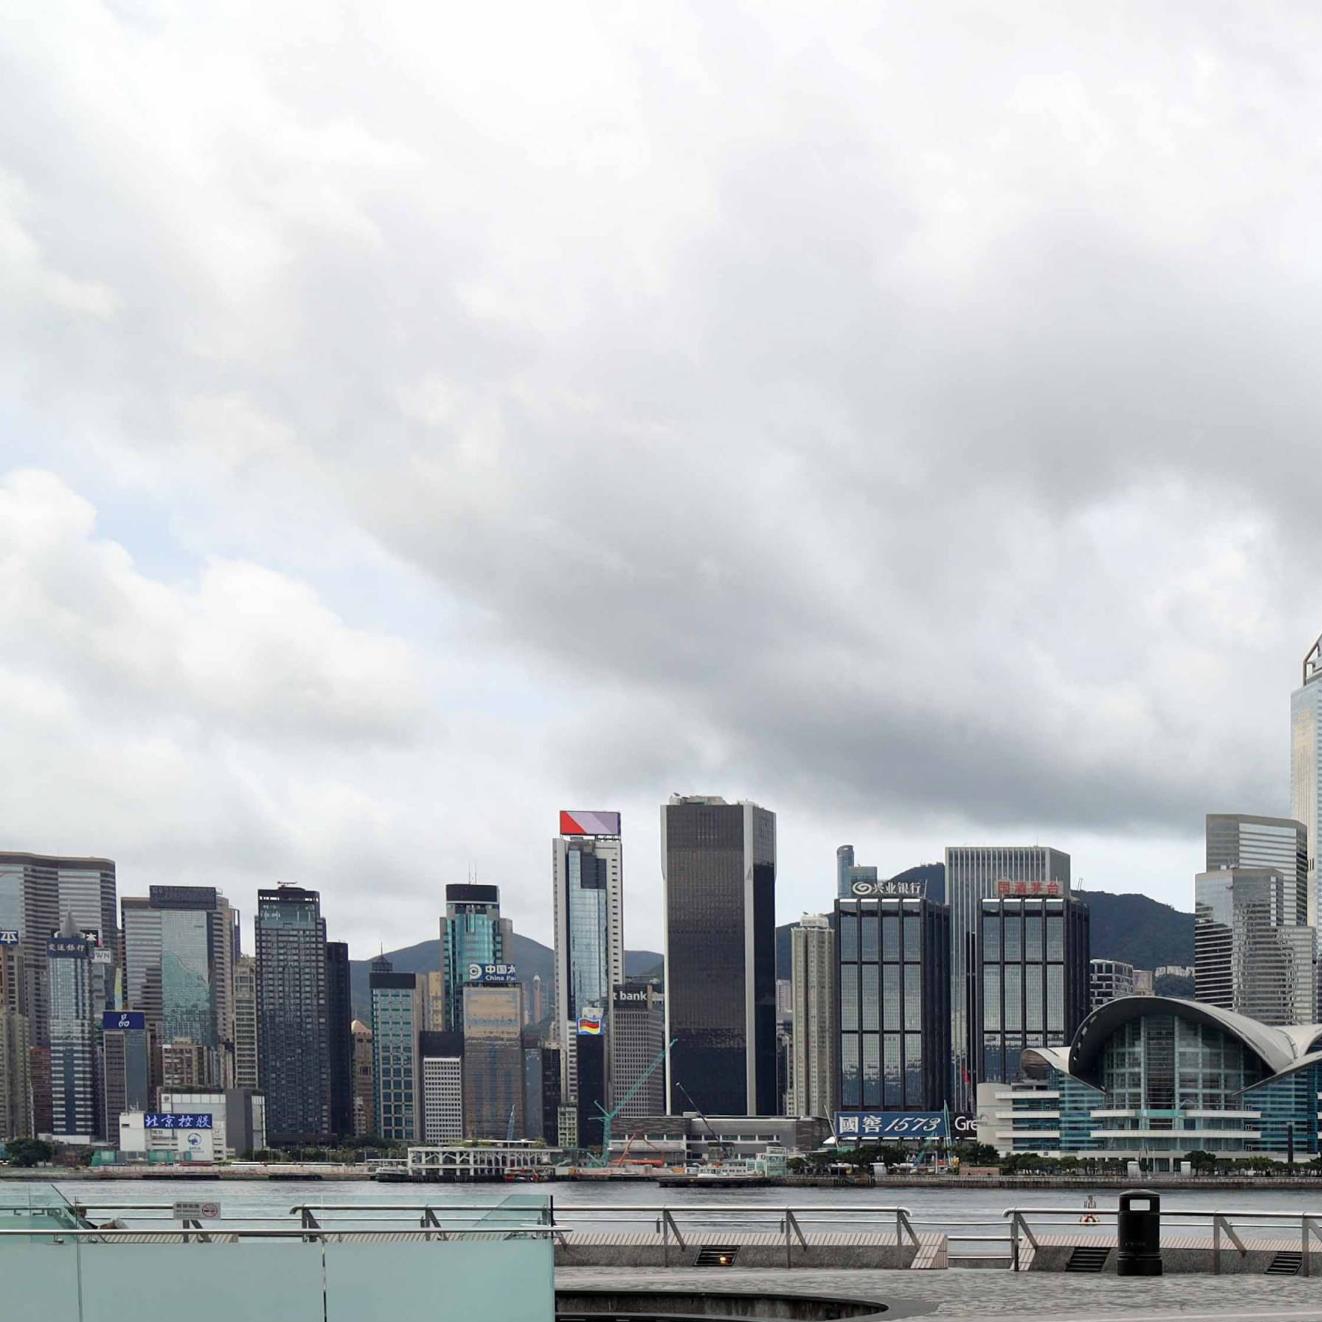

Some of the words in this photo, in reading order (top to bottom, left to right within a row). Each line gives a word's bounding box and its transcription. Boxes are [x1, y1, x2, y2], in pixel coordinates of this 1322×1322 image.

[620, 990, 647, 1000] bank
[145, 1114, 211, 1128] 北京控股
[884, 1117, 941, 1131] 1573
